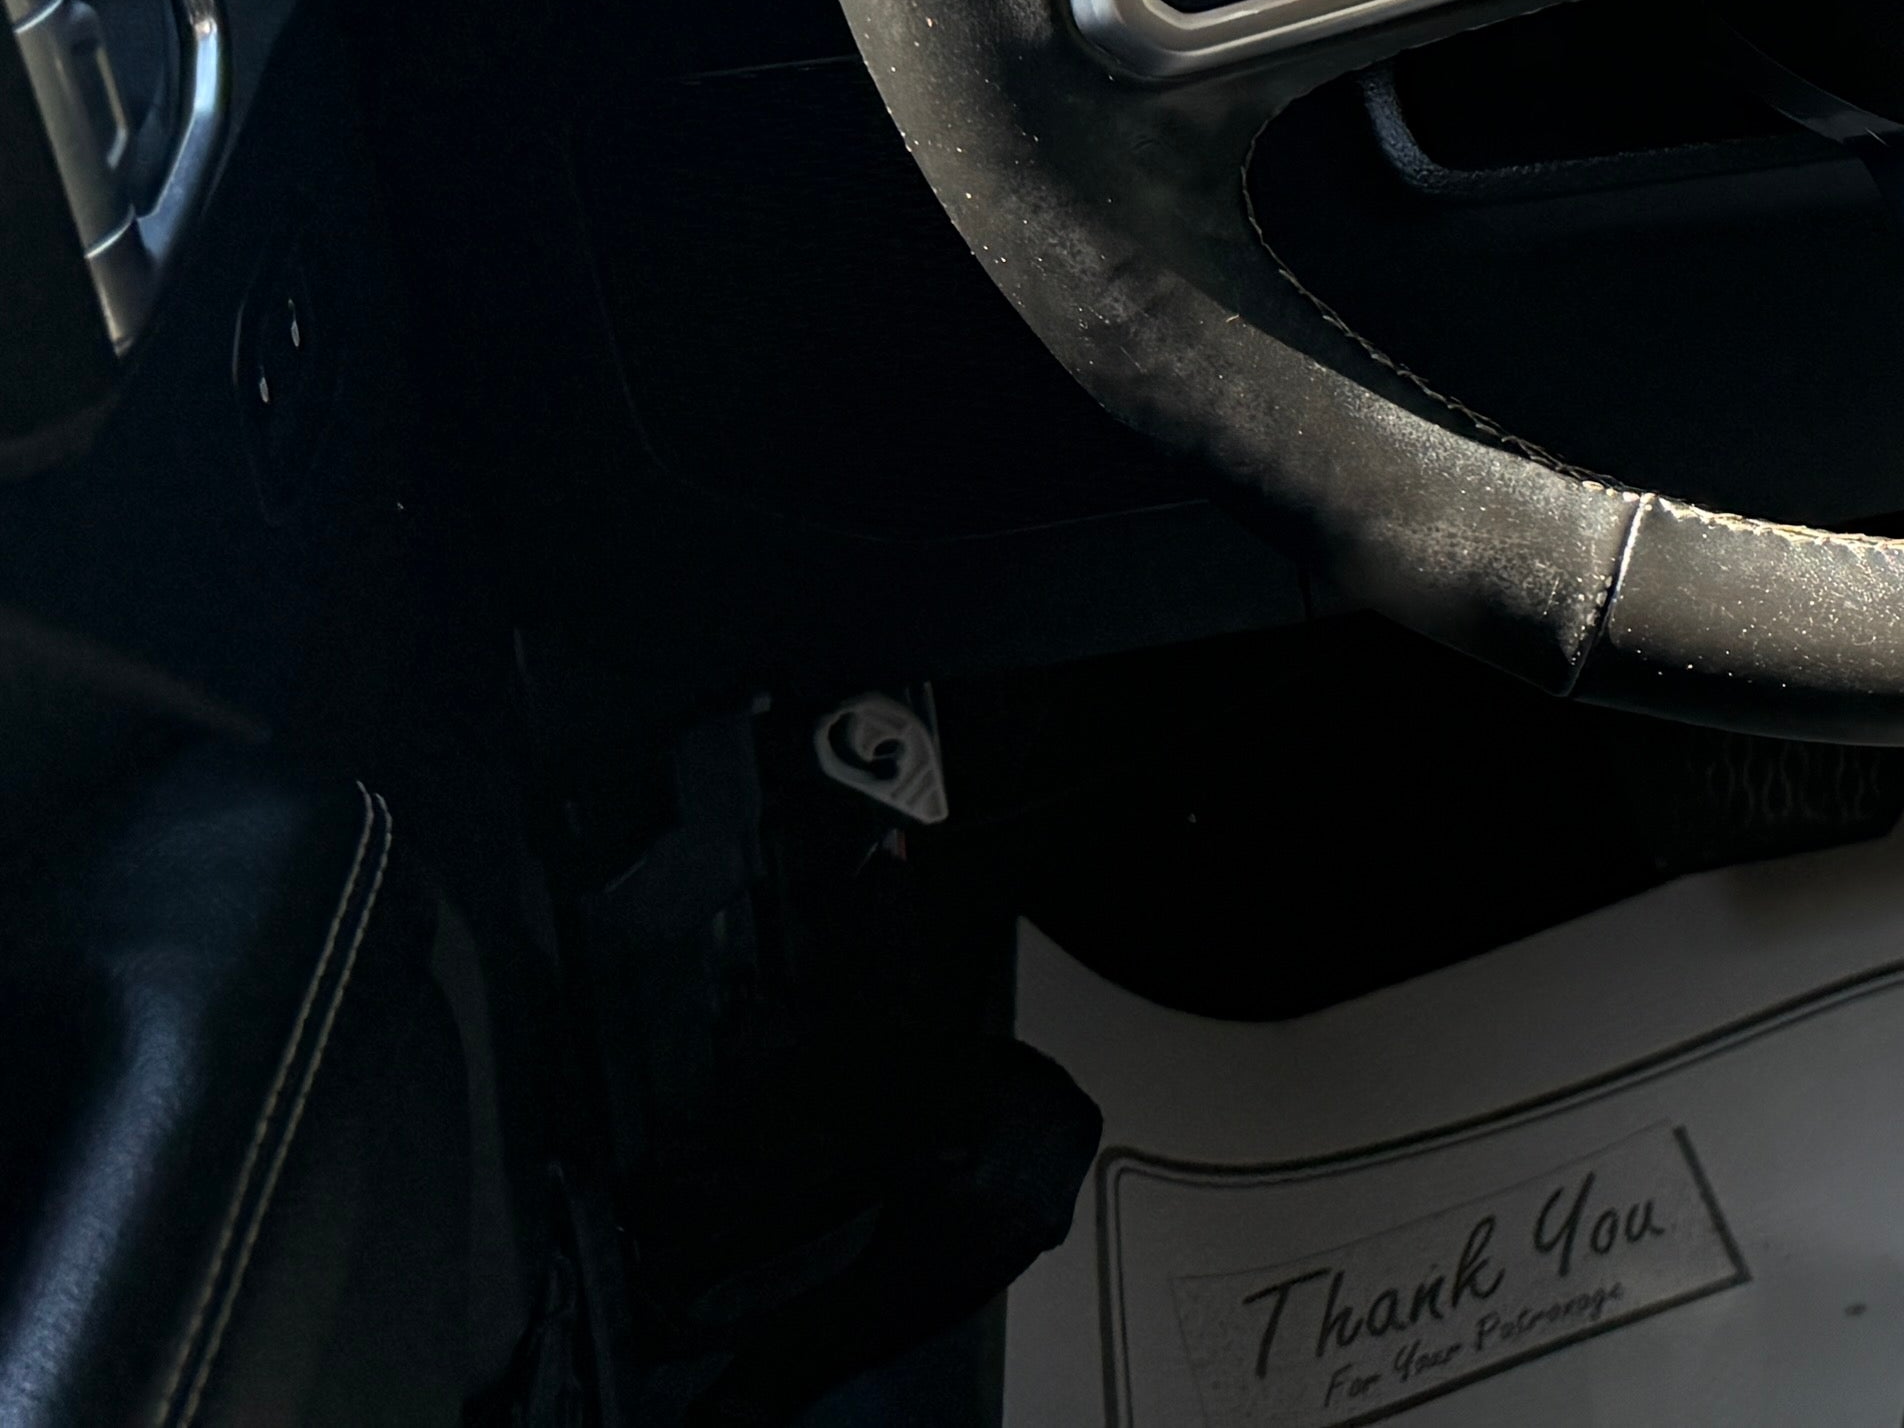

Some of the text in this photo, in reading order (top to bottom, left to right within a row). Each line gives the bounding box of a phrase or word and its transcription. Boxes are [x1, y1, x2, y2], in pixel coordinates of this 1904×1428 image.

[1242, 1171, 1665, 1379] Thank You
[1323, 1281, 1624, 1407] For Your Patronage
